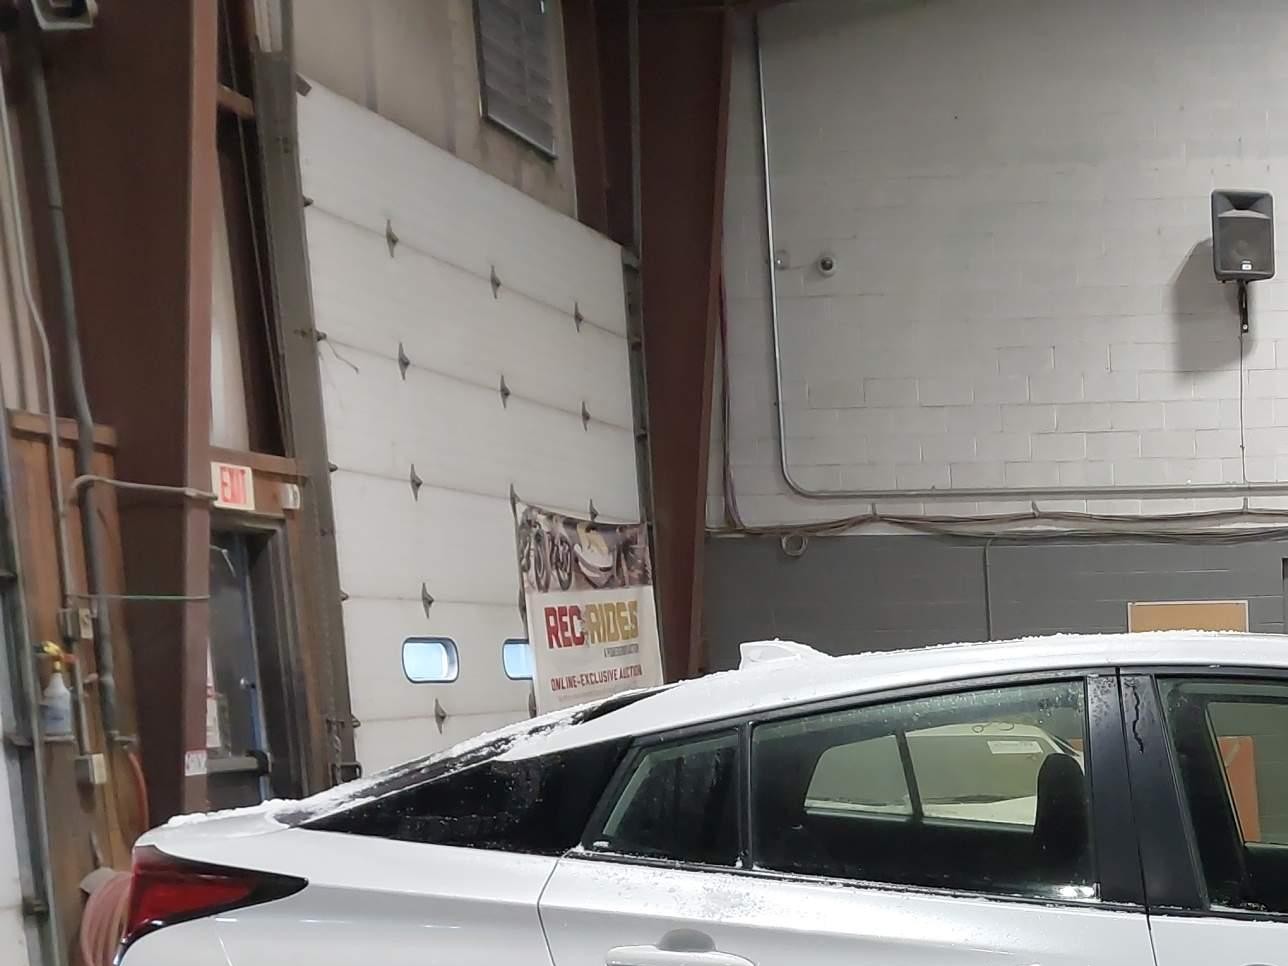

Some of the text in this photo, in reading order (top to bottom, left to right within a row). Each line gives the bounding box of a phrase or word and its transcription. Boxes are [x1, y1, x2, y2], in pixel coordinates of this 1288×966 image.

[220, 466, 246, 504] EXIT
[544, 600, 639, 650] REC RIDES
[551, 664, 643, 692] ONLINE-EXCLUSIVE AUCTION
